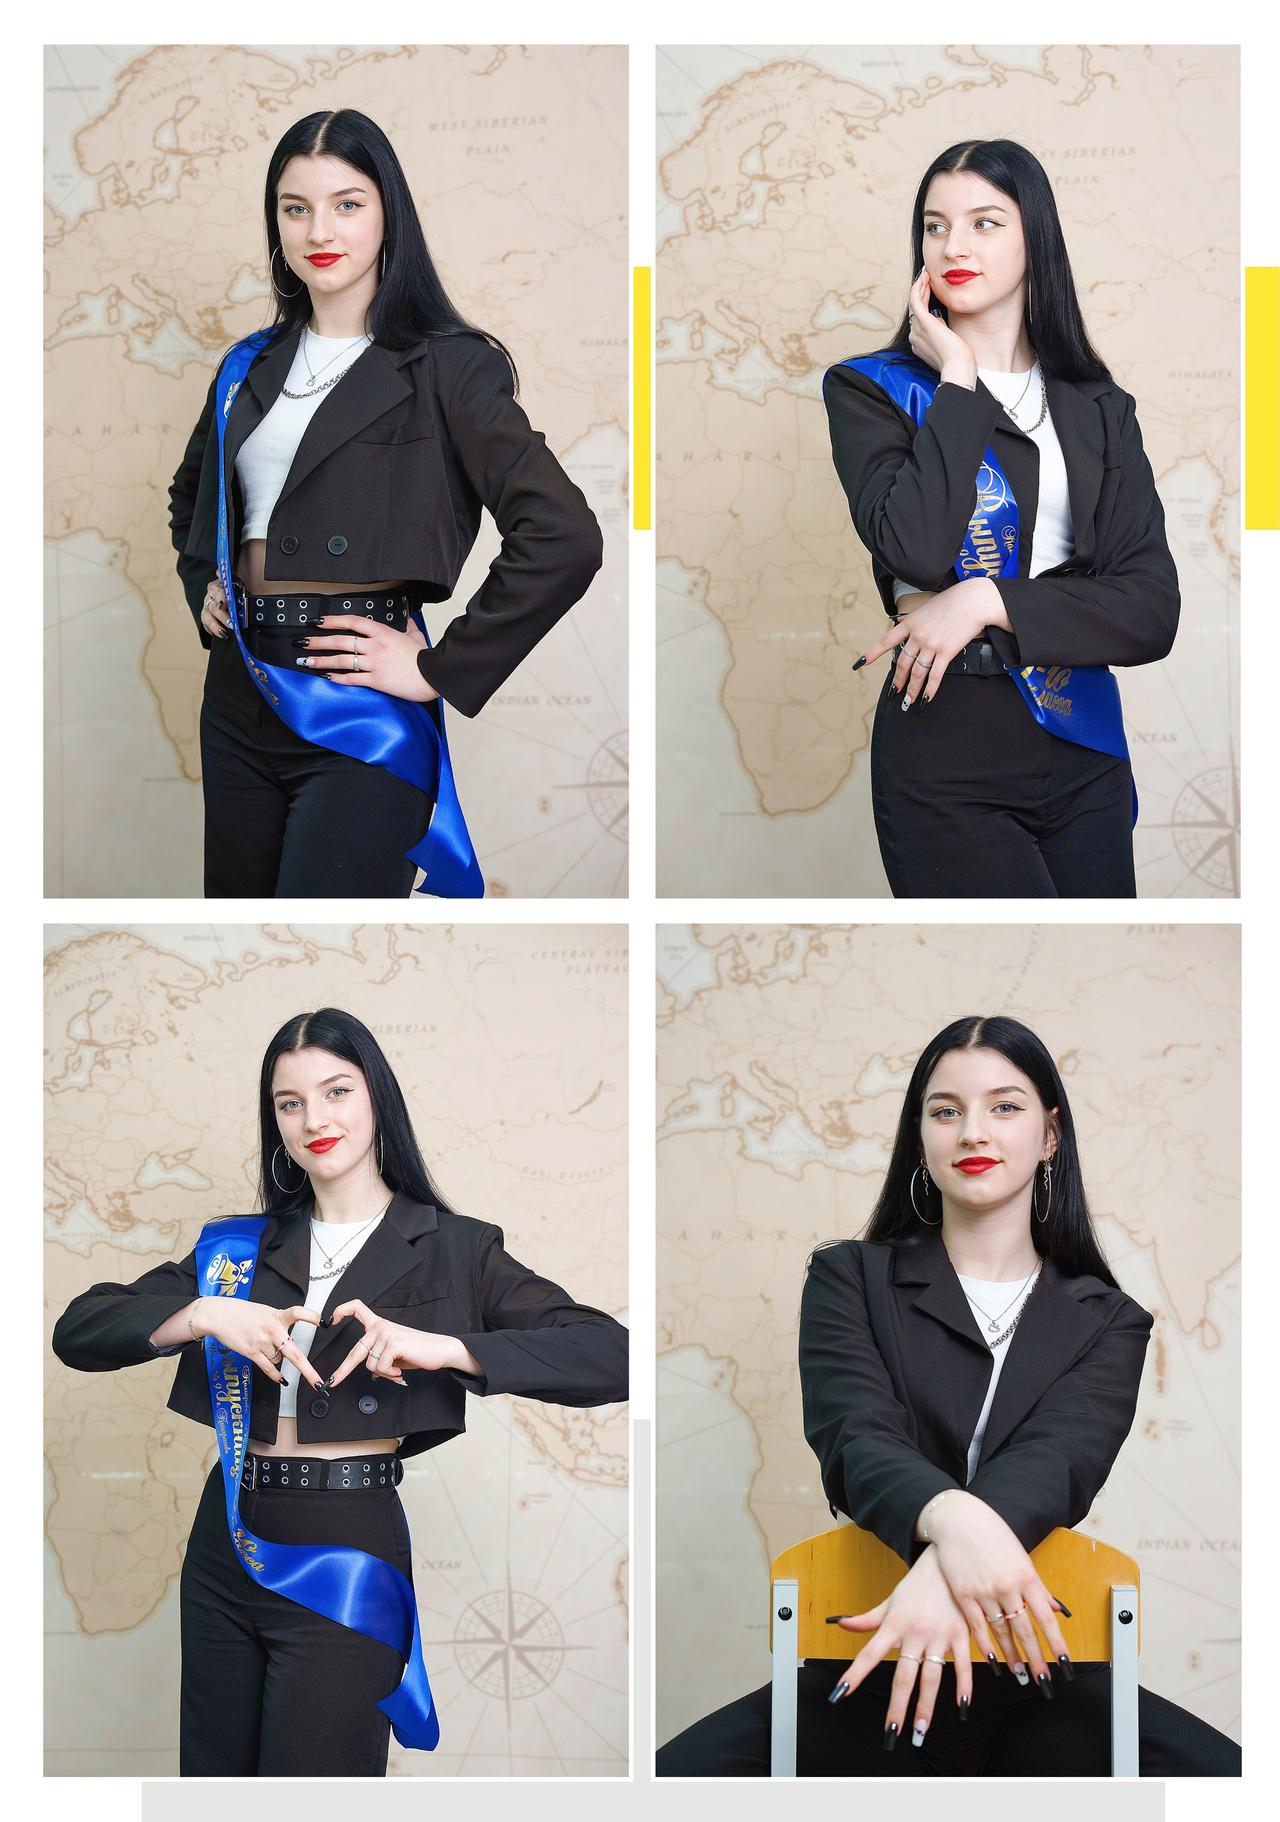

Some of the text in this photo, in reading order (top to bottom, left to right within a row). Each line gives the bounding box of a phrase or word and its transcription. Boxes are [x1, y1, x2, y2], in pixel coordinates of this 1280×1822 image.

[429, 115, 548, 132] WEST SIBERIAN
[466, 144, 510, 156] PLAIN
[1063, 146, 1138, 159] SIBERIAN
[1055, 174, 1100, 185] PLAIN
[491, 695, 592, 707] INDIAN OCEAN
[1132, 733, 1178, 743] OCEAN
[531, 950, 595, 960] CENTRAL
[53, 970, 118, 999] SCANDINAVIA
[1137, 1539, 1191, 1551] INDIAN
[421, 1560, 462, 1570] OCEAN
